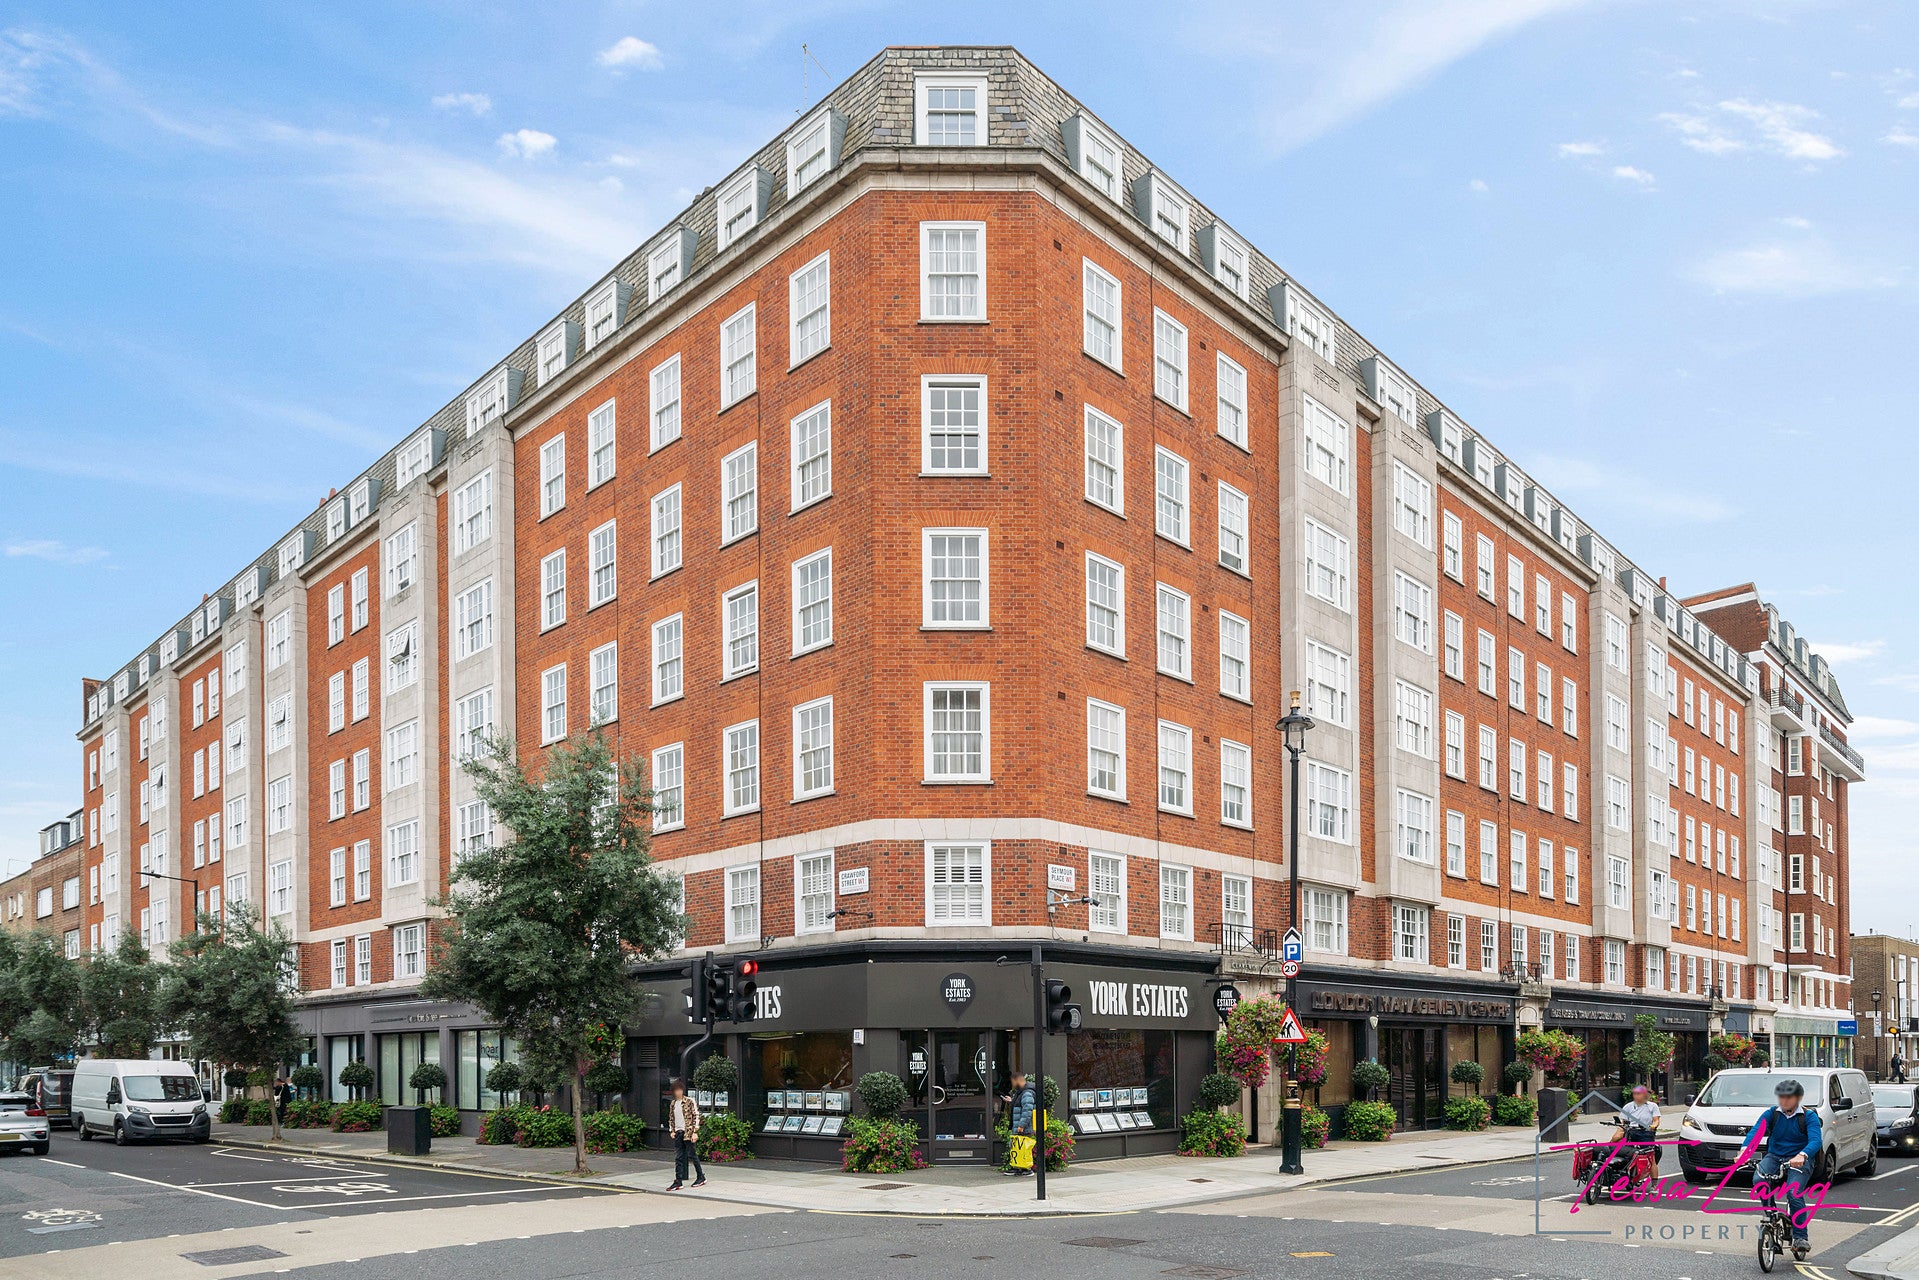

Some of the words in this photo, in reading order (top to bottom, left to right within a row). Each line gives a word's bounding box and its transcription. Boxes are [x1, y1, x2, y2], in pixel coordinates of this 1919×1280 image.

[841, 870, 866, 880] CRAWFORD
[1051, 866, 1073, 876] SEYMOUR
[841, 879, 857, 887] STREET
[1051, 874, 1065, 882] PLACE
[1287, 945, 1297, 959] P
[1284, 964, 1297, 973] 20
[949, 978, 966, 988] YORK
[945, 988, 971, 998] ESTATES
[1220, 990, 1233, 998] YORK
[1089, 980, 1128, 1016] YORK
[1132, 983, 1188, 1018] ESTATES
[1312, 991, 1375, 1012] LONDON
[909, 1061, 927, 1070] ESTATES
